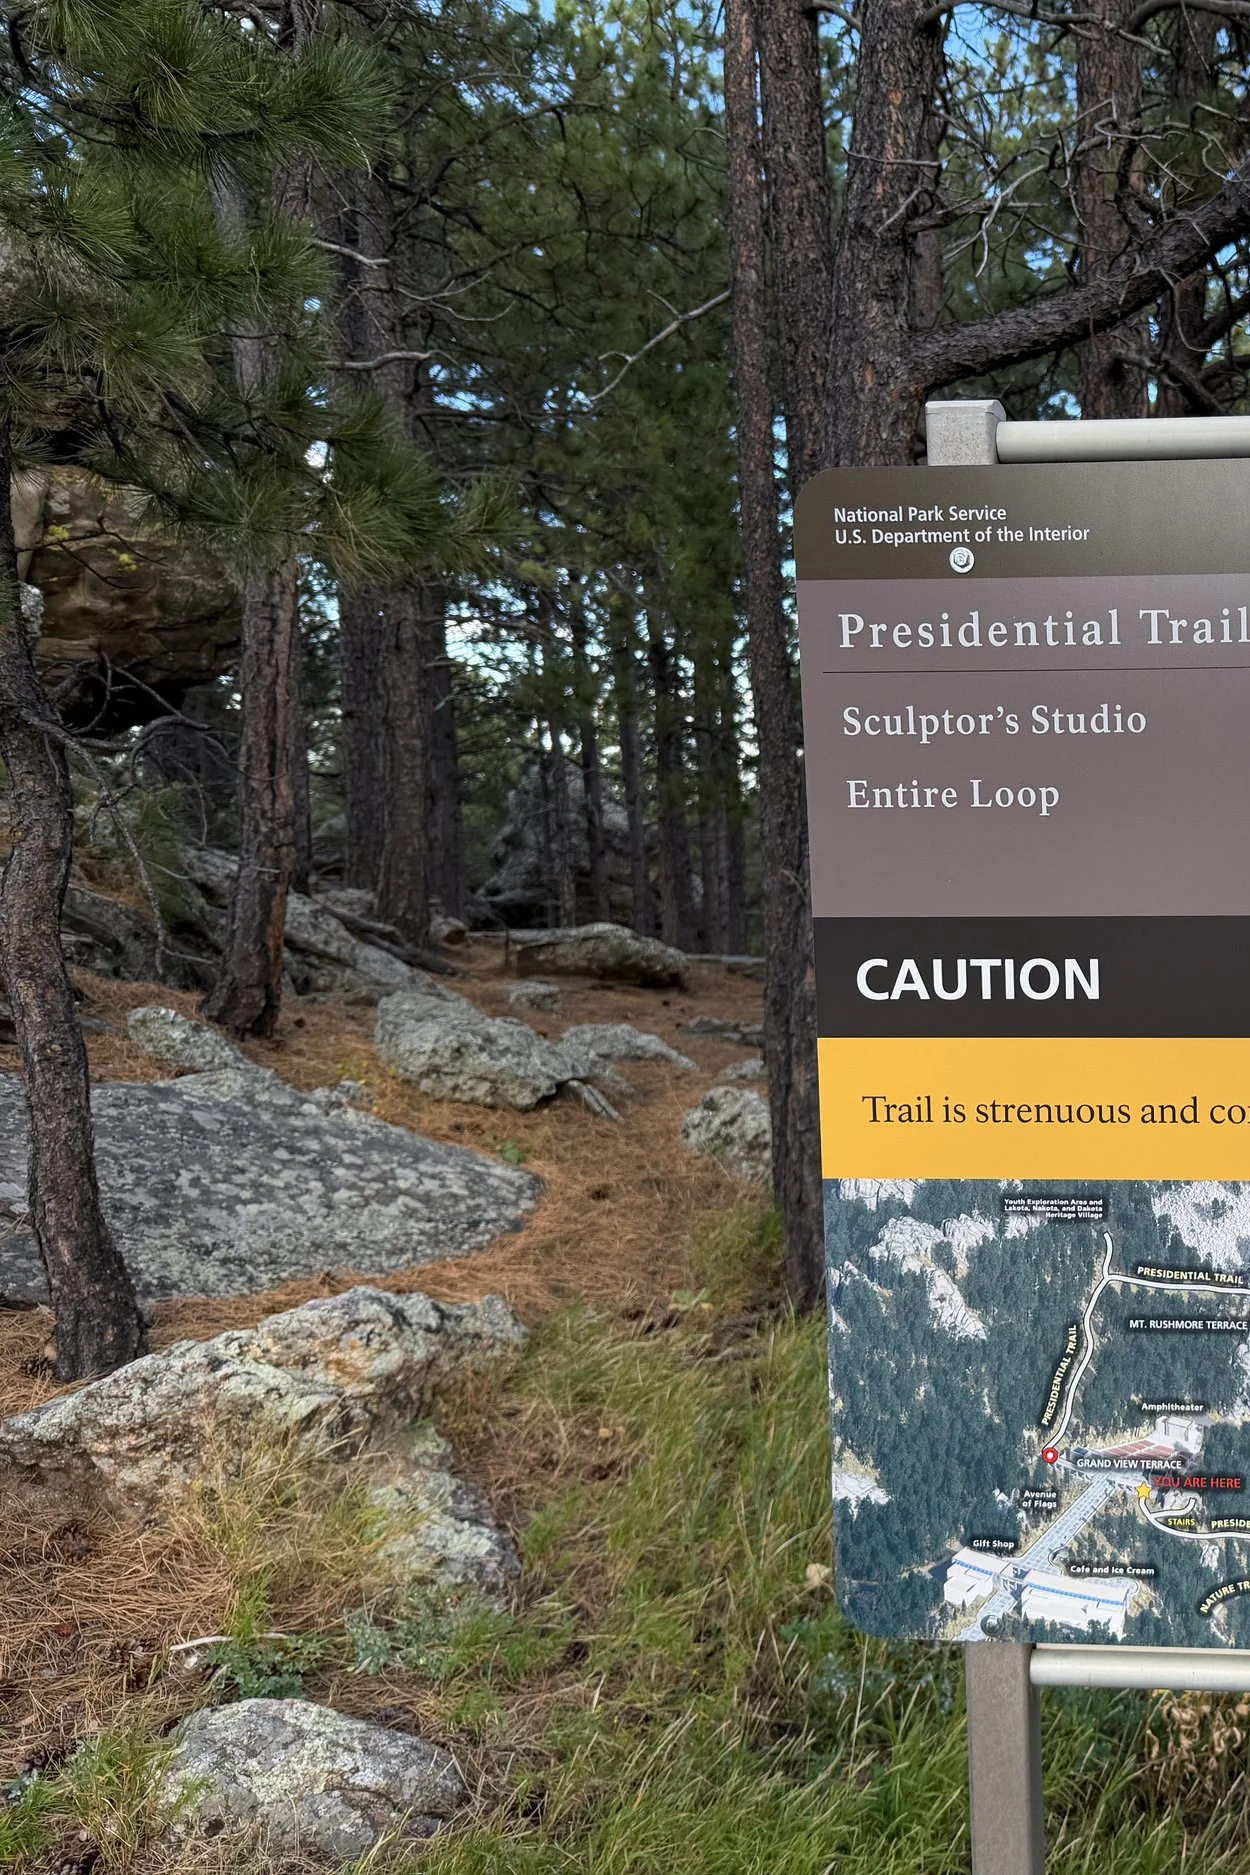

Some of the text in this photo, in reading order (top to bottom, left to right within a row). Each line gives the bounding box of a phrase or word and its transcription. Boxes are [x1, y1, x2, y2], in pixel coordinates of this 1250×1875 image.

[833, 505, 1007, 523] National Park Service
[835, 525, 1090, 547] U.S. Department of the Interior
[838, 609, 1122, 648] Presidential
[1031, 703, 1147, 735] Studio
[846, 779, 1060, 816] Entire Loop
[856, 957, 1100, 1000] CAUTION
[862, 1094, 935, 1125] Trail
[942, 1095, 967, 1124] is
[975, 1101, 1132, 1125] strenuous
[1140, 1096, 1200, 1126] and
[1137, 1266, 1244, 1285] PRESIDENTIAL TRAIL
[1129, 1319, 1248, 1330] MT. RUSHMORE TERRACE
[1041, 1324, 1077, 1426] PRESIDENTIAL TRAIL
[1141, 1402, 1204, 1413] Amphitheater
[1077, 1459, 1182, 1469] GRAND VIEW TERRACE
[1154, 1477, 1241, 1488] YOU ARE HERE
[1022, 1499, 1057, 1509] of Flags
[1023, 1490, 1057, 1500] Avenue
[1167, 1518, 1196, 1527] STAIRS
[972, 1539, 1015, 1549] Gift Shop
[1070, 1565, 1155, 1576] Cafe and Ice Cream
[1200, 1584, 1236, 1614] NATURE
